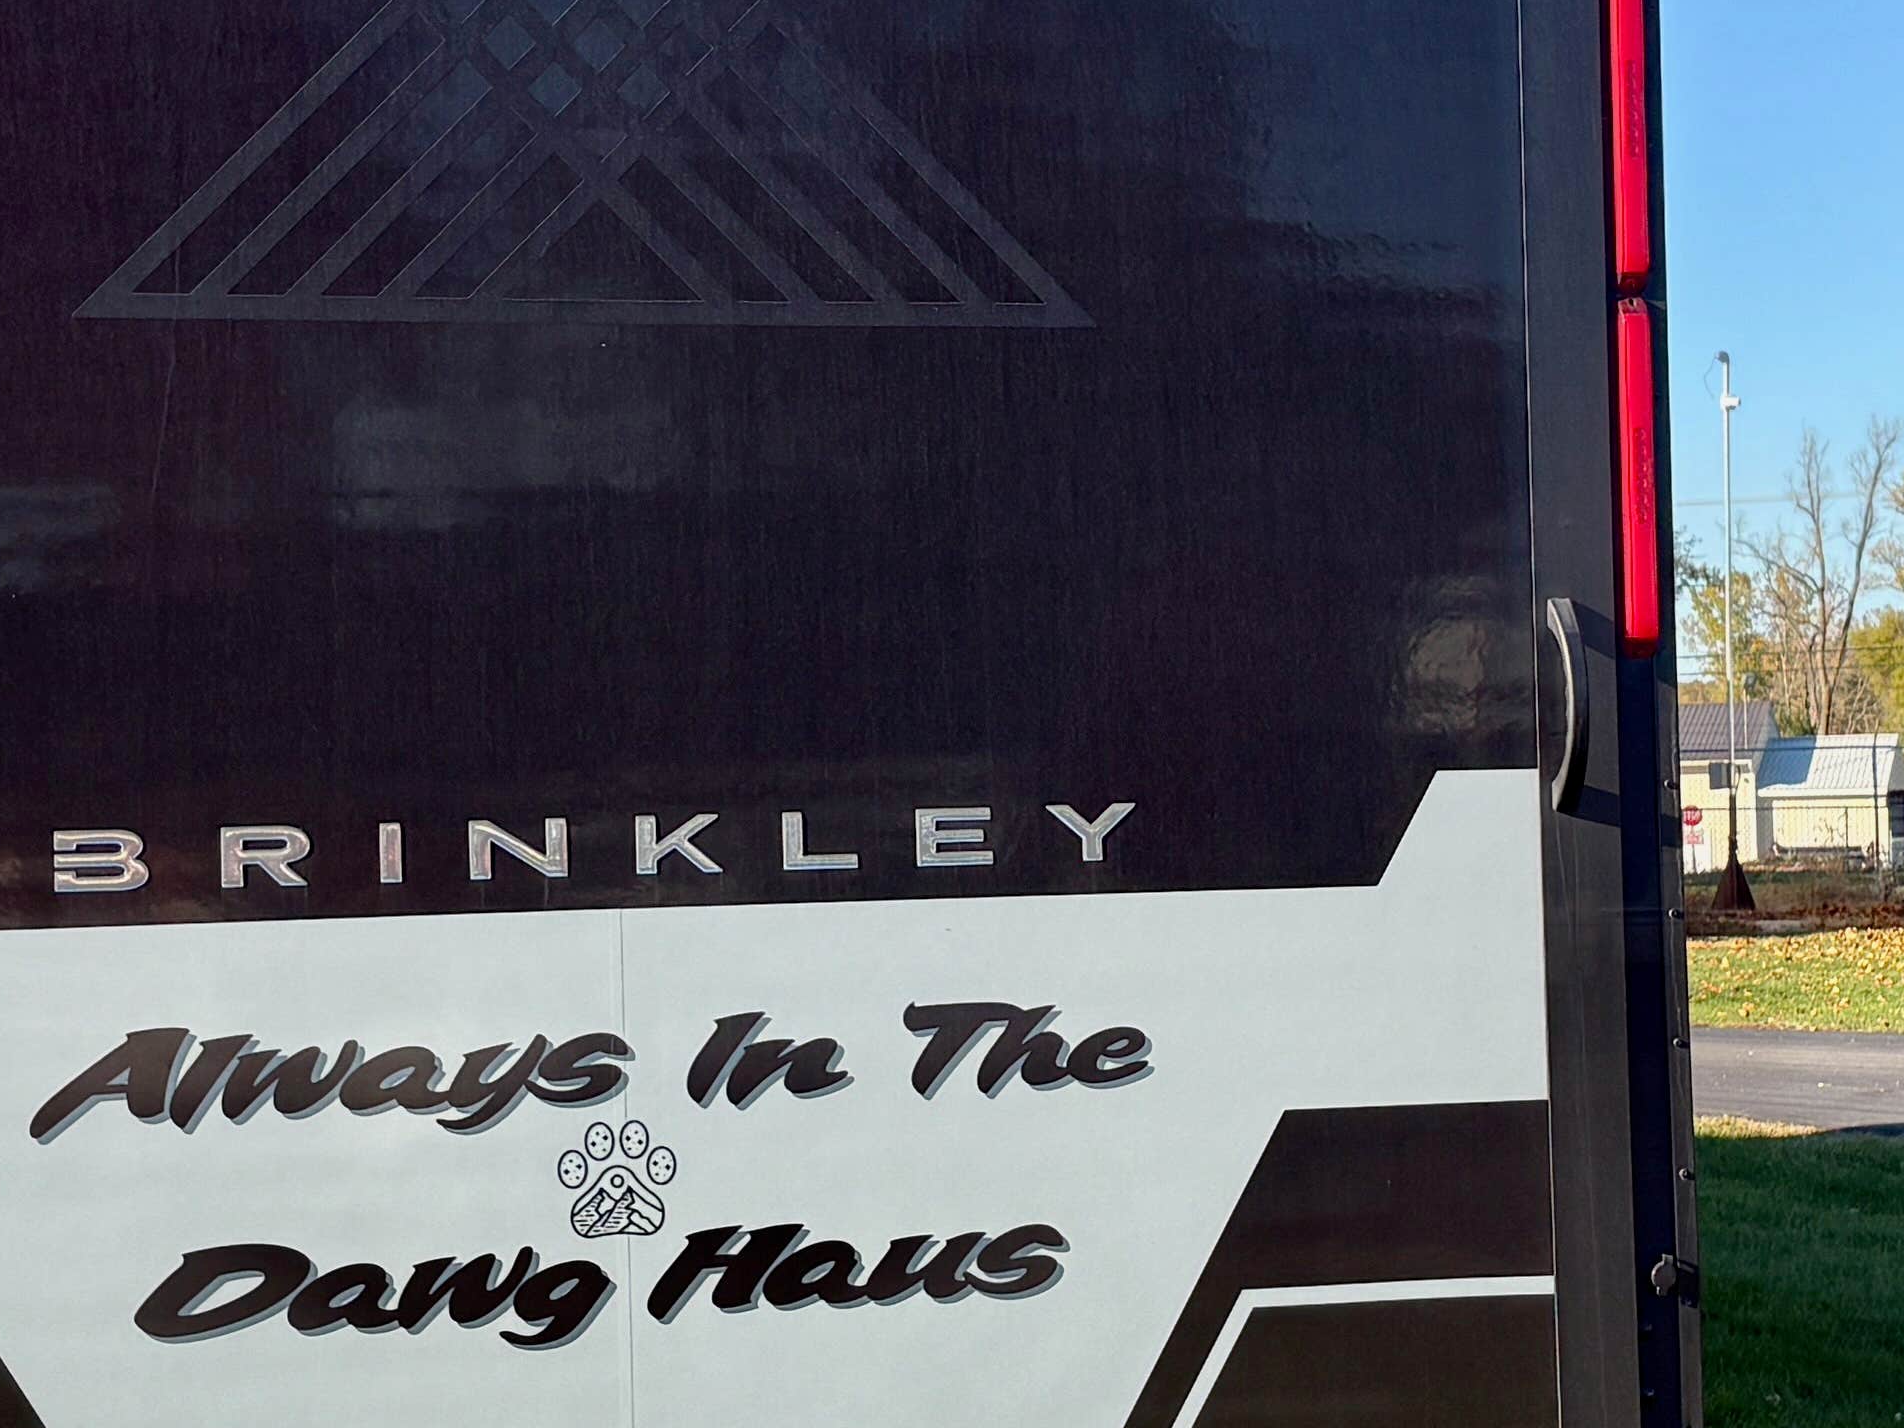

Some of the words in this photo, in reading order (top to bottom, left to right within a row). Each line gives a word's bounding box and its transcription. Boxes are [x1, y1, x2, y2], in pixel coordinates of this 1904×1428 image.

[52, 802, 1136, 893] BRINKLEY
[29, 1026, 636, 1143] Always
[686, 1012, 855, 1108] In
[903, 1001, 1155, 1100] The
[133, 1242, 616, 1348] Dawg
[647, 1223, 1071, 1324] Haus
